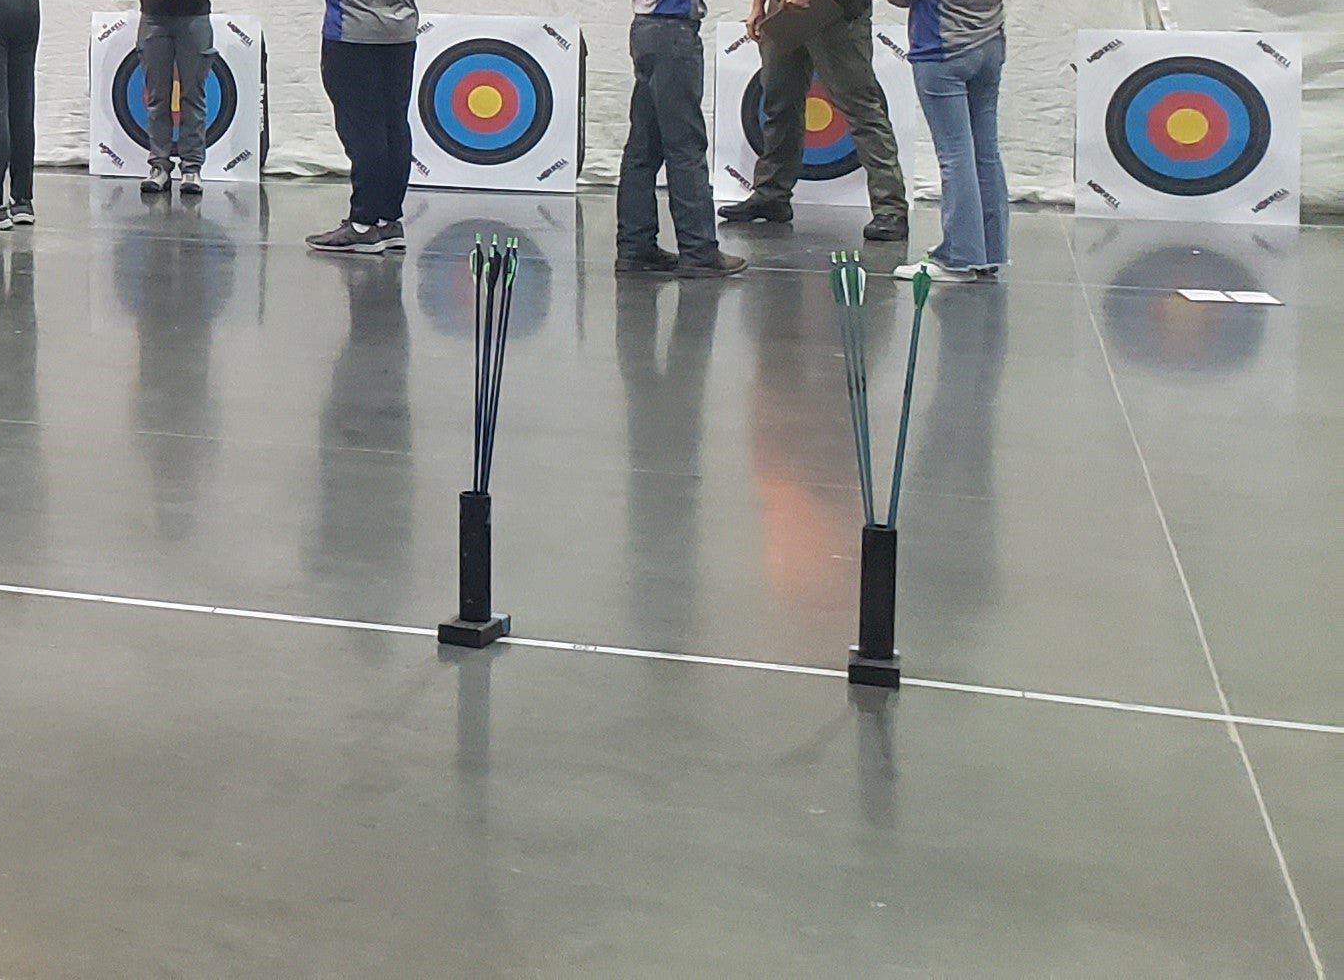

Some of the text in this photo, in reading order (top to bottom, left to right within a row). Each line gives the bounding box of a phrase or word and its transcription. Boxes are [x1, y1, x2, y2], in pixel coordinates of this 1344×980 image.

[1086, 38, 1124, 63] MORRELL
[1256, 39, 1292, 68] MORRELL
[1086, 179, 1121, 209] MORRELL
